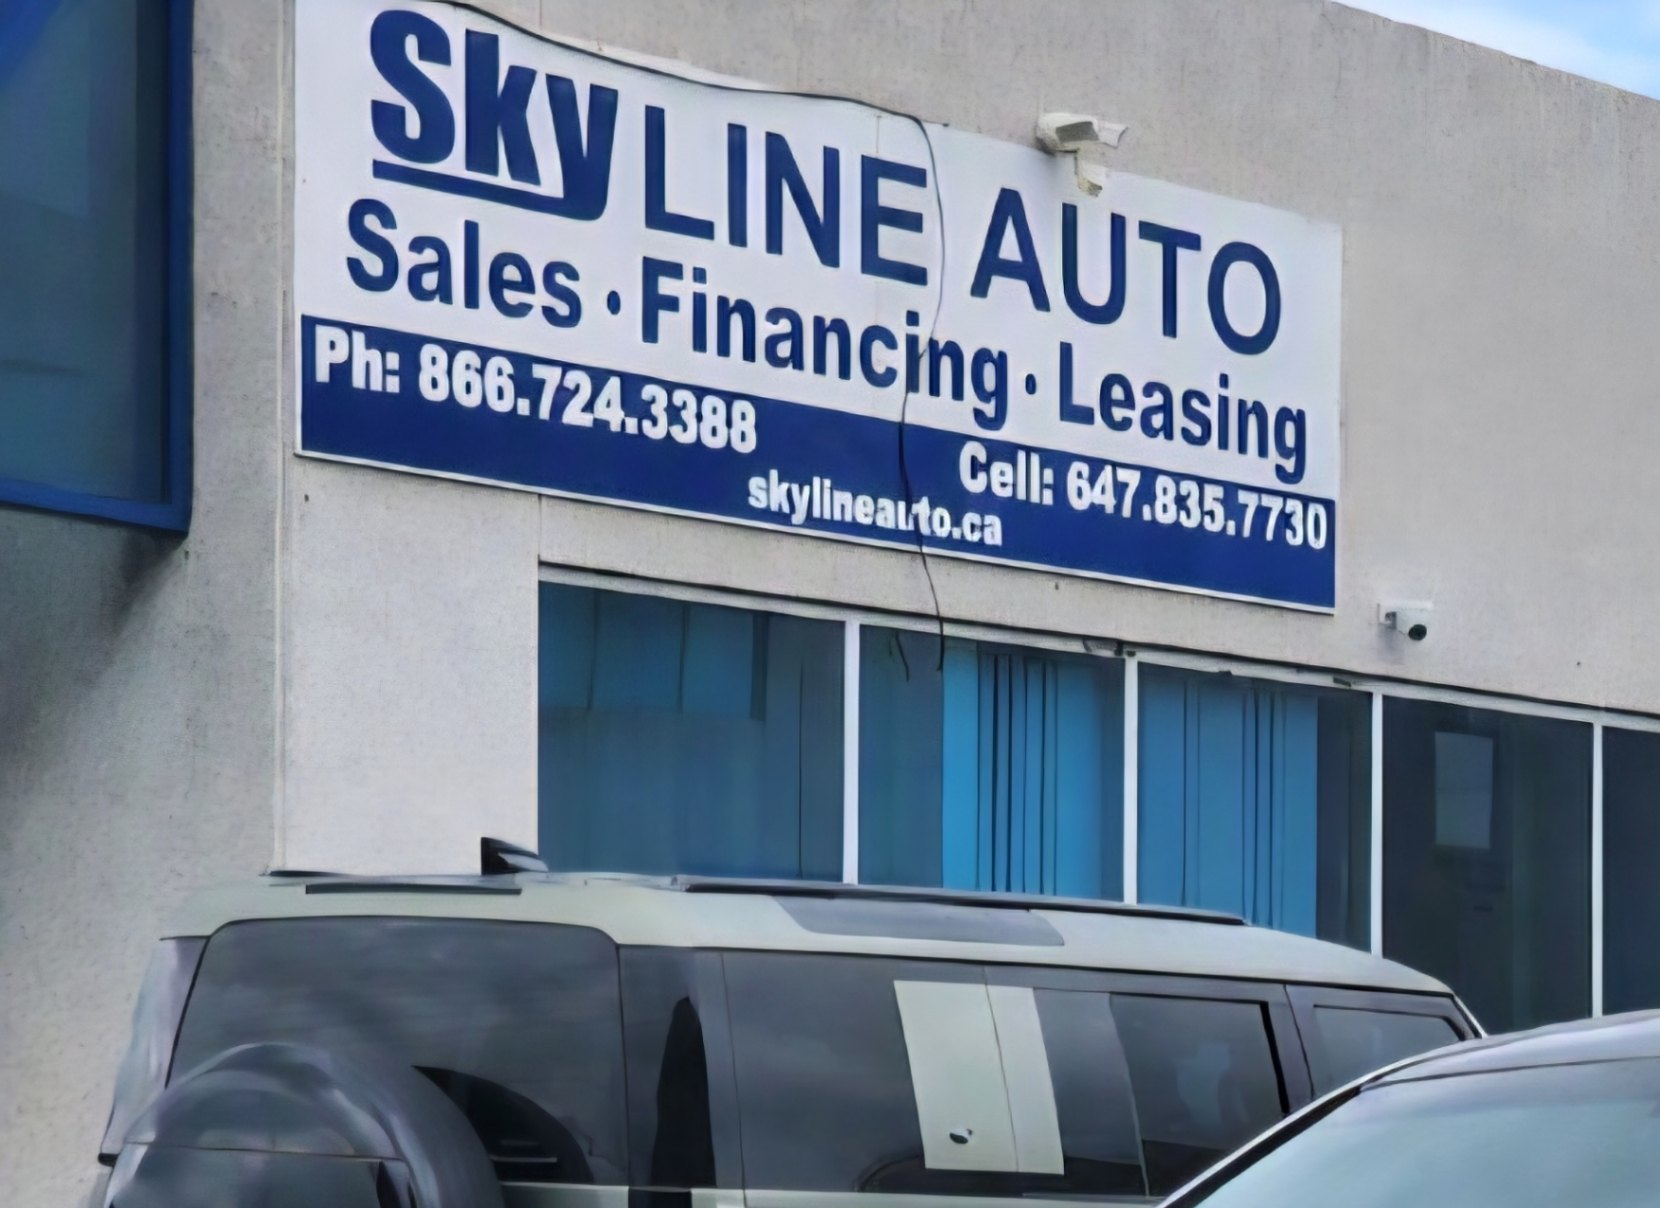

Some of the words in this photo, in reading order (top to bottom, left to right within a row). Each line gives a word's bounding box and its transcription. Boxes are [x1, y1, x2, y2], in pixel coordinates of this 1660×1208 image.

[970, 187, 1281, 355] AUTO
[314, 325, 400, 394] Ph:
[418, 344, 757, 453] 866.724.3388
[346, 198, 583, 329] Sales
[641, 255, 1009, 431] Financing
[1059, 341, 1306, 484] Leasing
[747, 468, 1003, 547] skylineauto.ca
[958, 441, 1054, 506] Cell:
[1066, 462, 1328, 550] 647.835.7730
